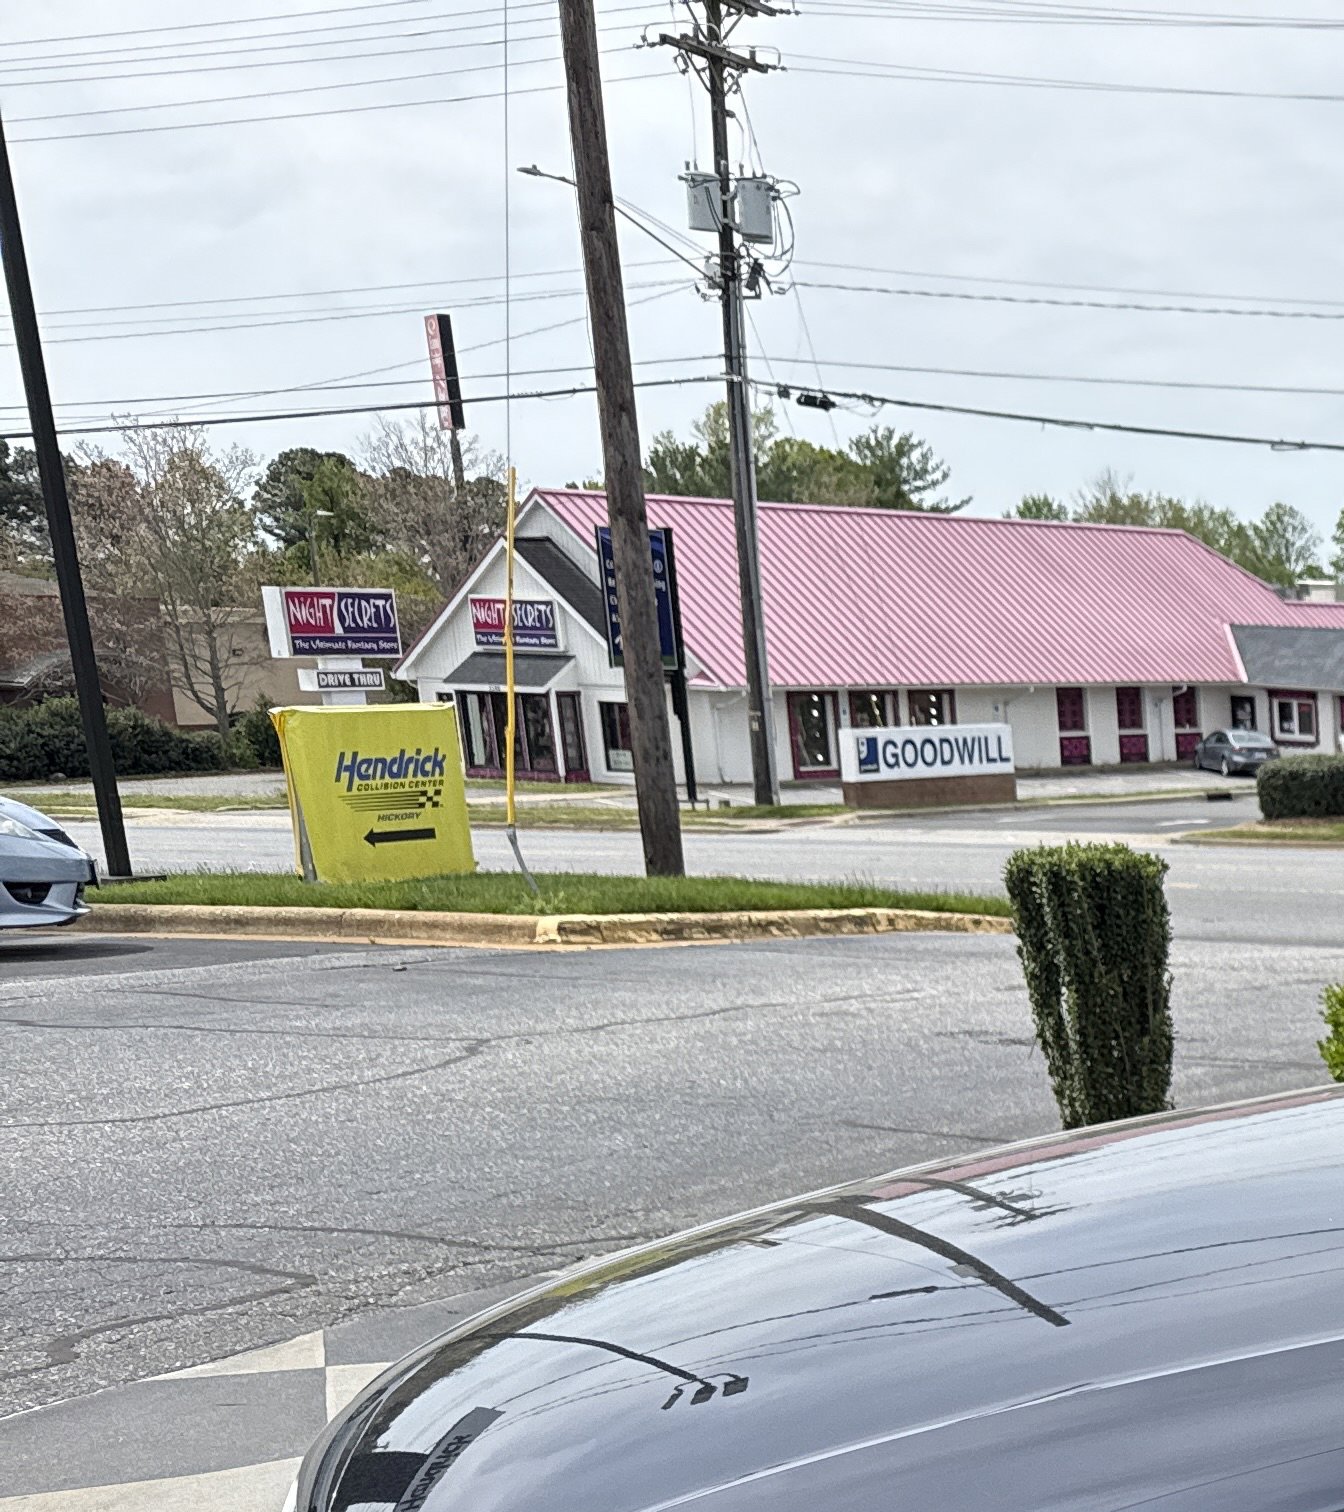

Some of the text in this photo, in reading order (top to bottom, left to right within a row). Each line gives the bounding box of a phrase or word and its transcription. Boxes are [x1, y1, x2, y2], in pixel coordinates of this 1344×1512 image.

[340, 598, 395, 629] SECRETS
[319, 673, 380, 686] DRIVE THRU
[882, 735, 1012, 769] GOODWILL
[335, 747, 447, 792] Hendrick
[356, 779, 445, 792] COLLISION CENTER
[377, 812, 422, 823] HICKORY
